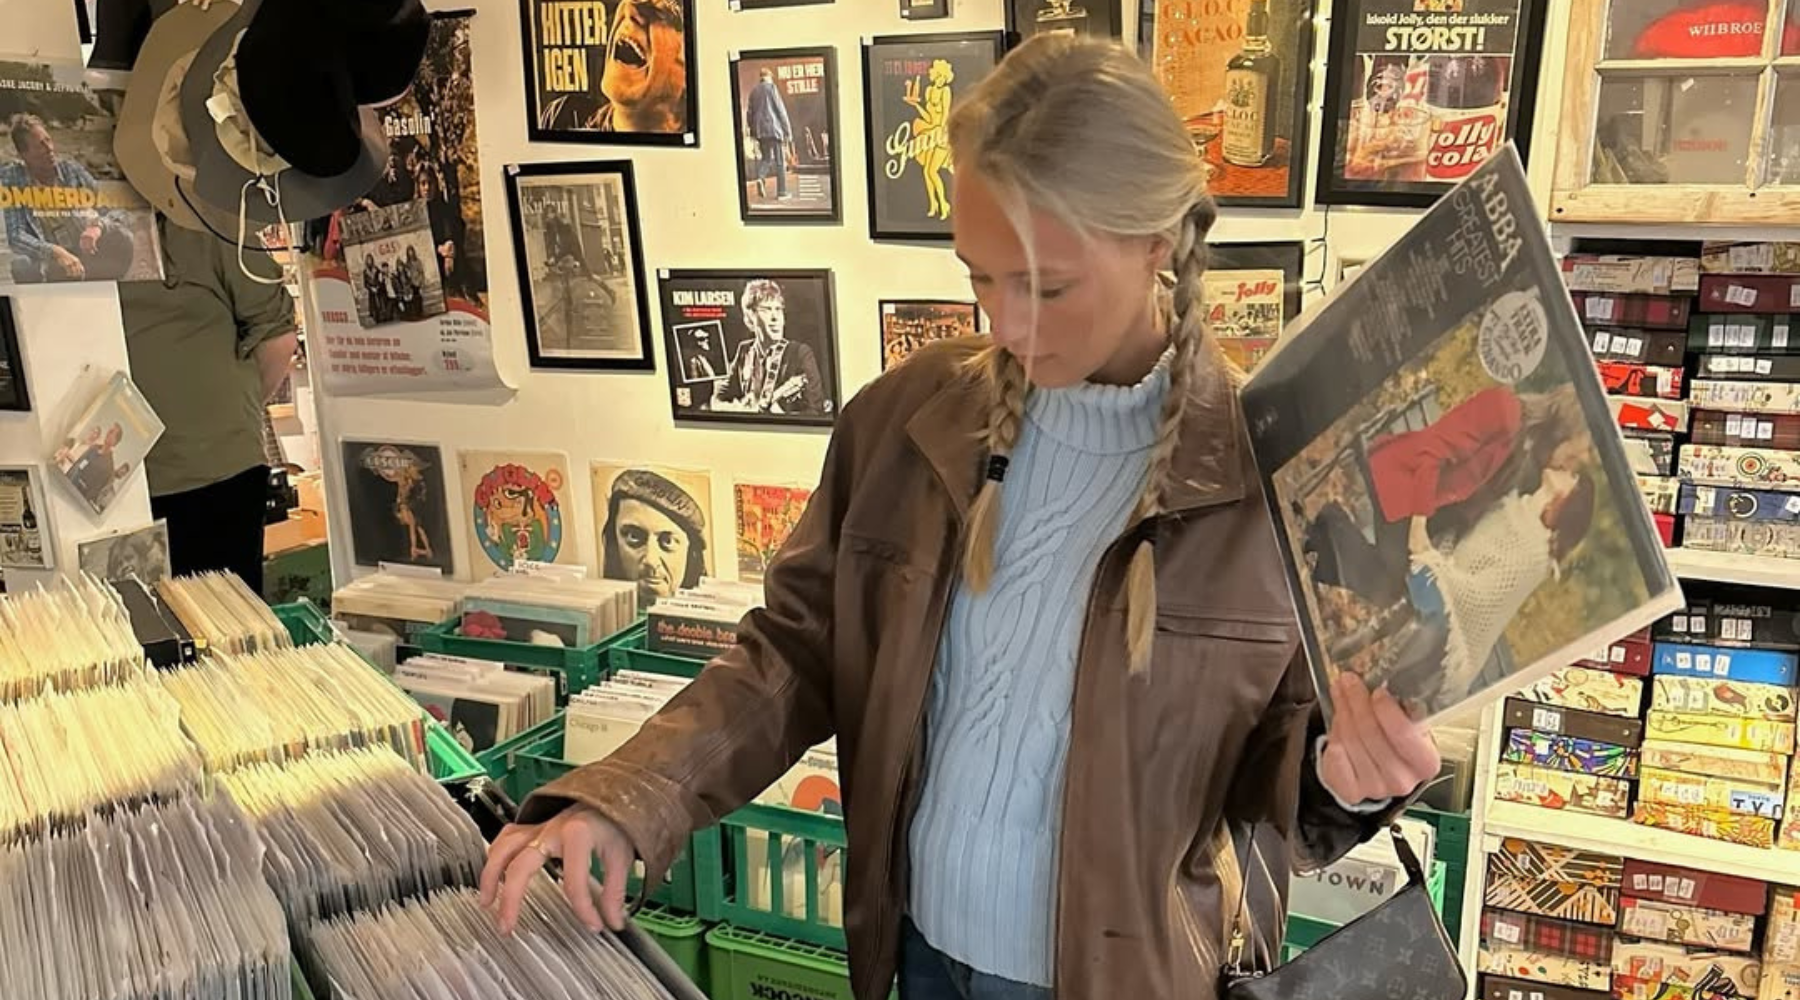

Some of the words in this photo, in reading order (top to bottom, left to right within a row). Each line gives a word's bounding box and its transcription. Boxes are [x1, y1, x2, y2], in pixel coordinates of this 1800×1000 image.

[541, 2, 607, 45] HITTER
[1366, 13, 1397, 25] Iskold
[1398, 13, 1424, 27] Jolly,
[1426, 14, 1448, 25] den
[1449, 14, 1468, 25] der
[1470, 14, 1510, 25] slukker
[1689, 22, 1763, 37] WIIBROE
[1164, 23, 1243, 49] CACAO
[1385, 26, 1486, 51] STØRST!
[543, 48, 588, 92] IGEN
[786, 78, 819, 95] STILLE
[384, 105, 436, 137] Gasolin'
[1427, 145, 1491, 166] cola
[1470, 172, 1523, 273] ABBA
[1452, 188, 1499, 289] GREATEST
[1445, 229, 1473, 276] HITS
[672, 290, 694, 306] KIM
[695, 290, 735, 306] LARSEN
[657, 618, 674, 635] the
[677, 622, 713, 640] doobie
